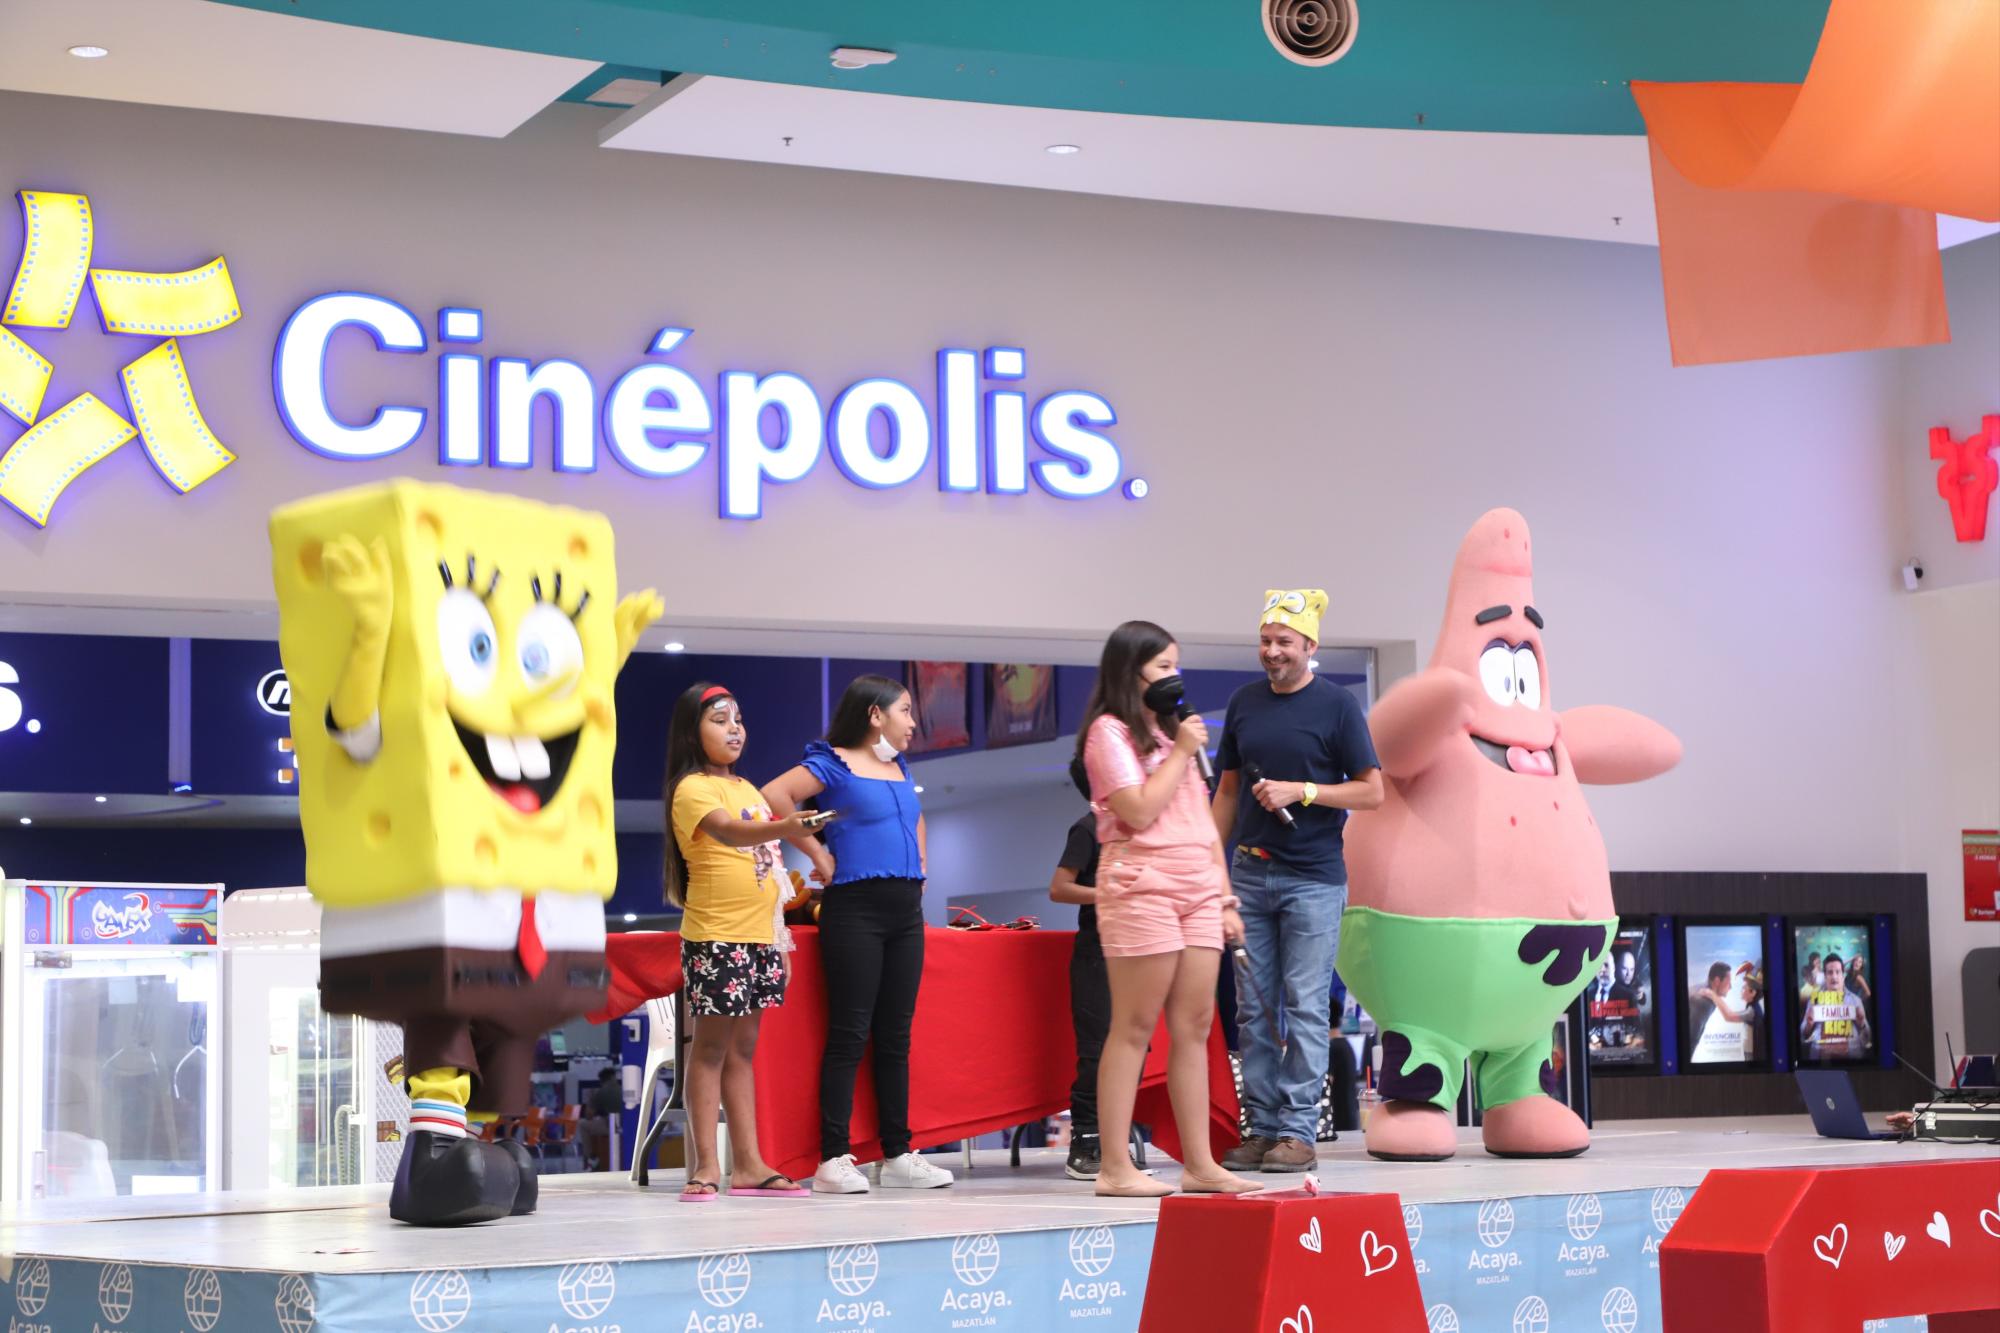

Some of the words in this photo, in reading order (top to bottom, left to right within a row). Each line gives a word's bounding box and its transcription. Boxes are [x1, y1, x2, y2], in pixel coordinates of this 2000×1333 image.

[1810, 991, 1845, 1005] POBRE
[1822, 1007, 1850, 1018] FAMILIA
[1824, 1020, 1853, 1036] RICA
[1468, 1249, 1522, 1273] Acaya.
[1557, 1242, 1610, 1265] Acaya.
[940, 1288, 1012, 1314] Acaya.
[1059, 1278, 1127, 1304] Acaya.
[684, 1309, 764, 1333] Acaya.
[816, 1298, 892, 1326] Acaya.
[952, 1317, 996, 1329] MAZATLÁN
